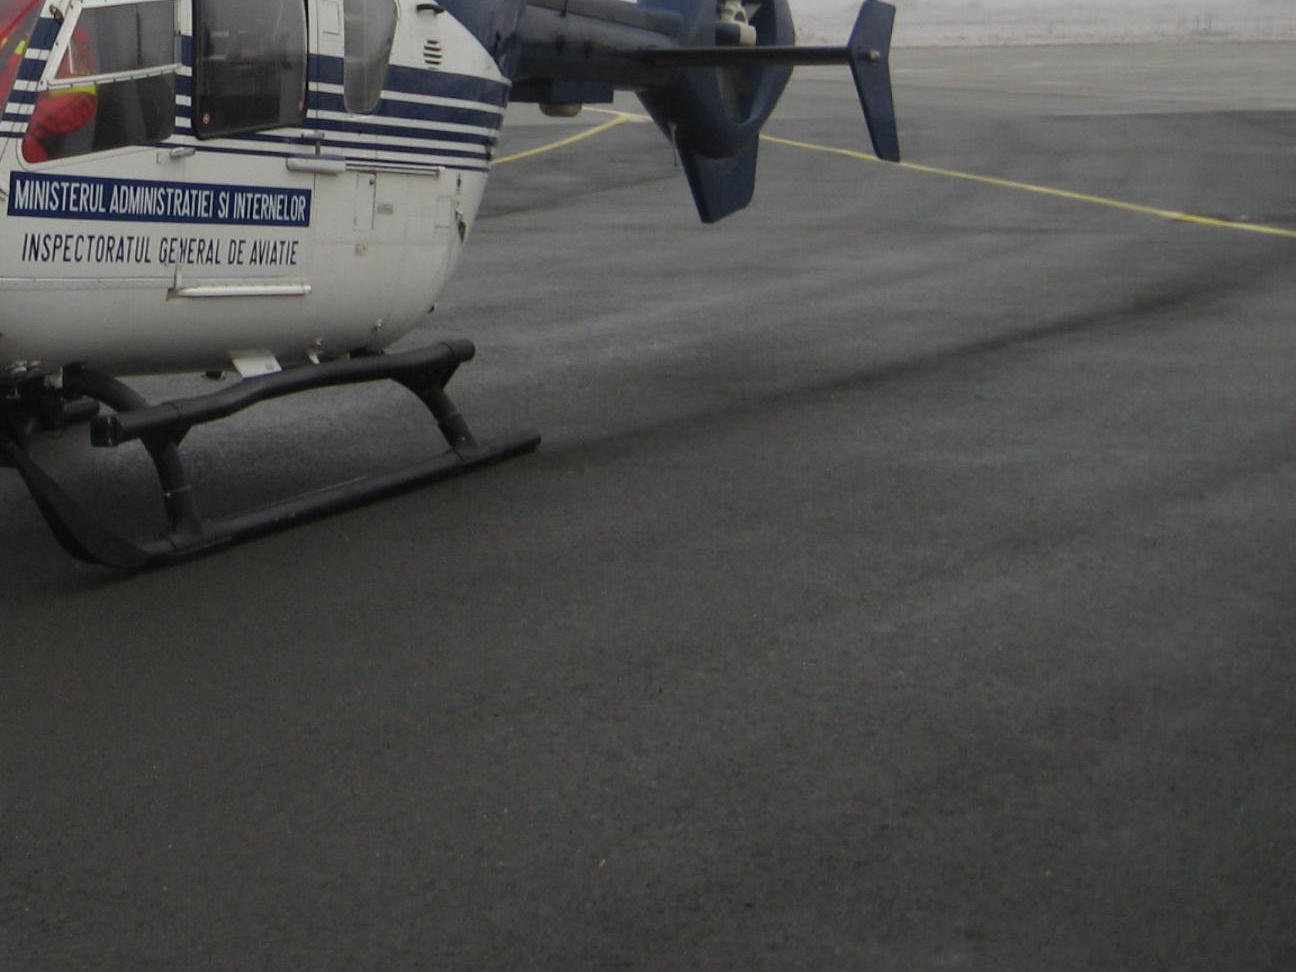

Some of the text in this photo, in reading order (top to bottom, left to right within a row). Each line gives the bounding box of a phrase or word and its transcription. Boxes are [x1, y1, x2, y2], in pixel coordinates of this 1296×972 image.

[14, 179, 306, 222] MINISTERUL ADMINISTRATIEI SI INTERNELOR
[21, 233, 299, 266] INSPECTORATUL GENERAL DE AVIATIE
